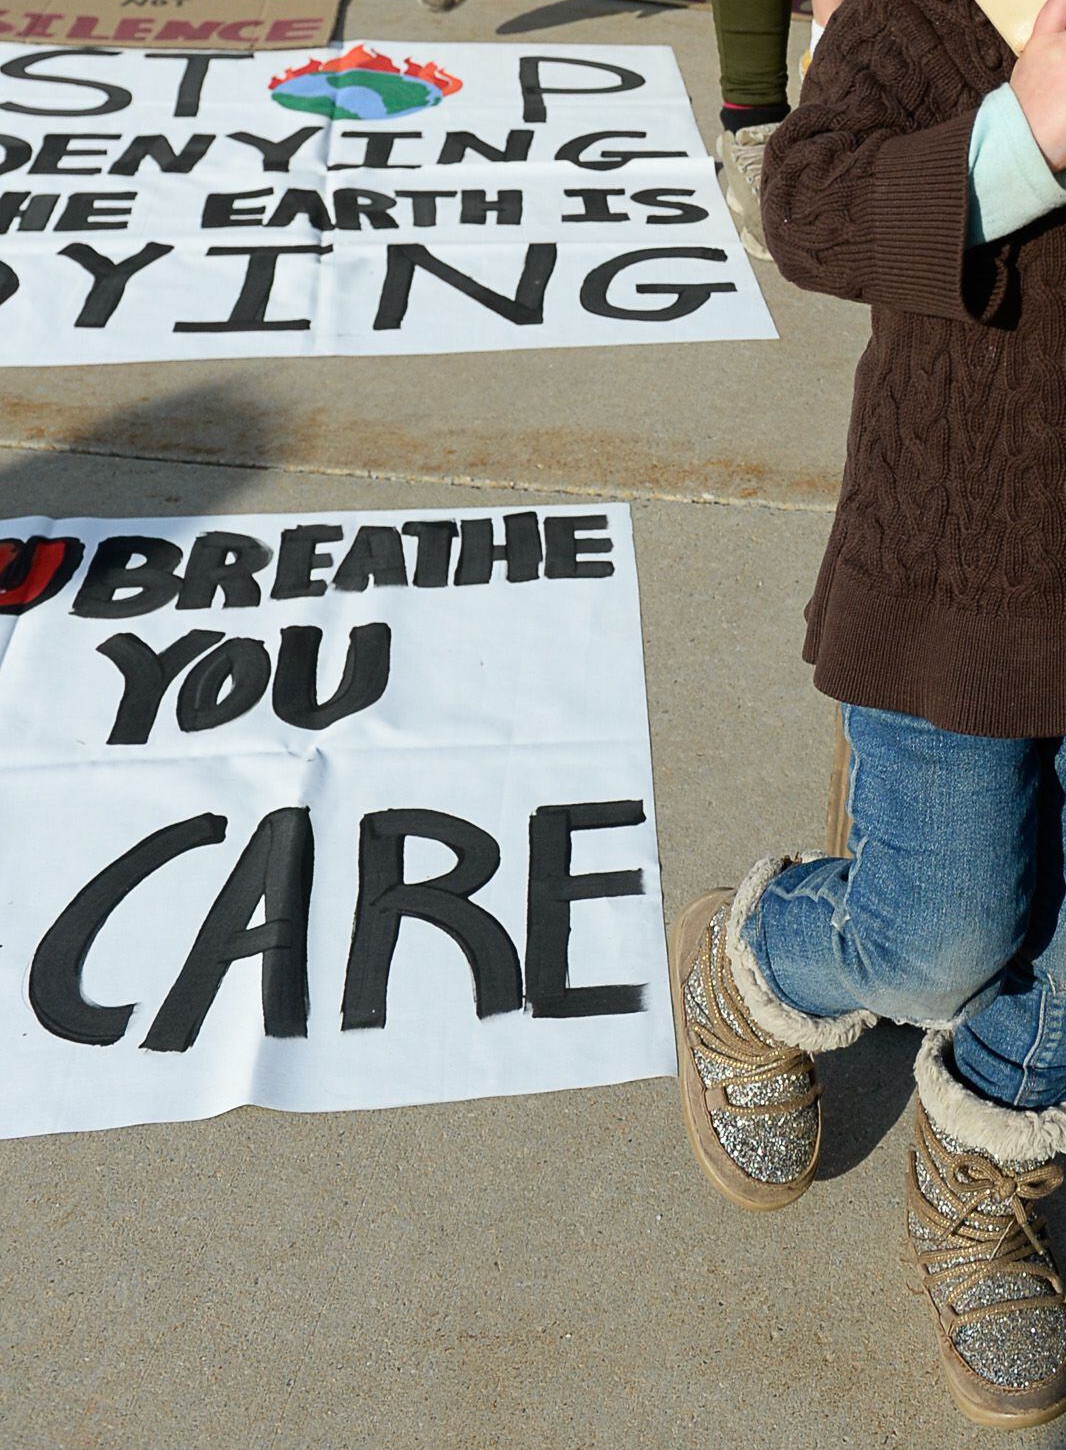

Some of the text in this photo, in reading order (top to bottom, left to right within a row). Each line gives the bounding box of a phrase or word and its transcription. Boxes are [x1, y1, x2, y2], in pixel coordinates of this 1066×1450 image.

[201, 187, 523, 231] EARTH
[560, 188, 710, 225] IS
[68, 511, 616, 618] BREATHE
[95, 623, 392, 745] YOU
[27, 800, 649, 1053] CARE
